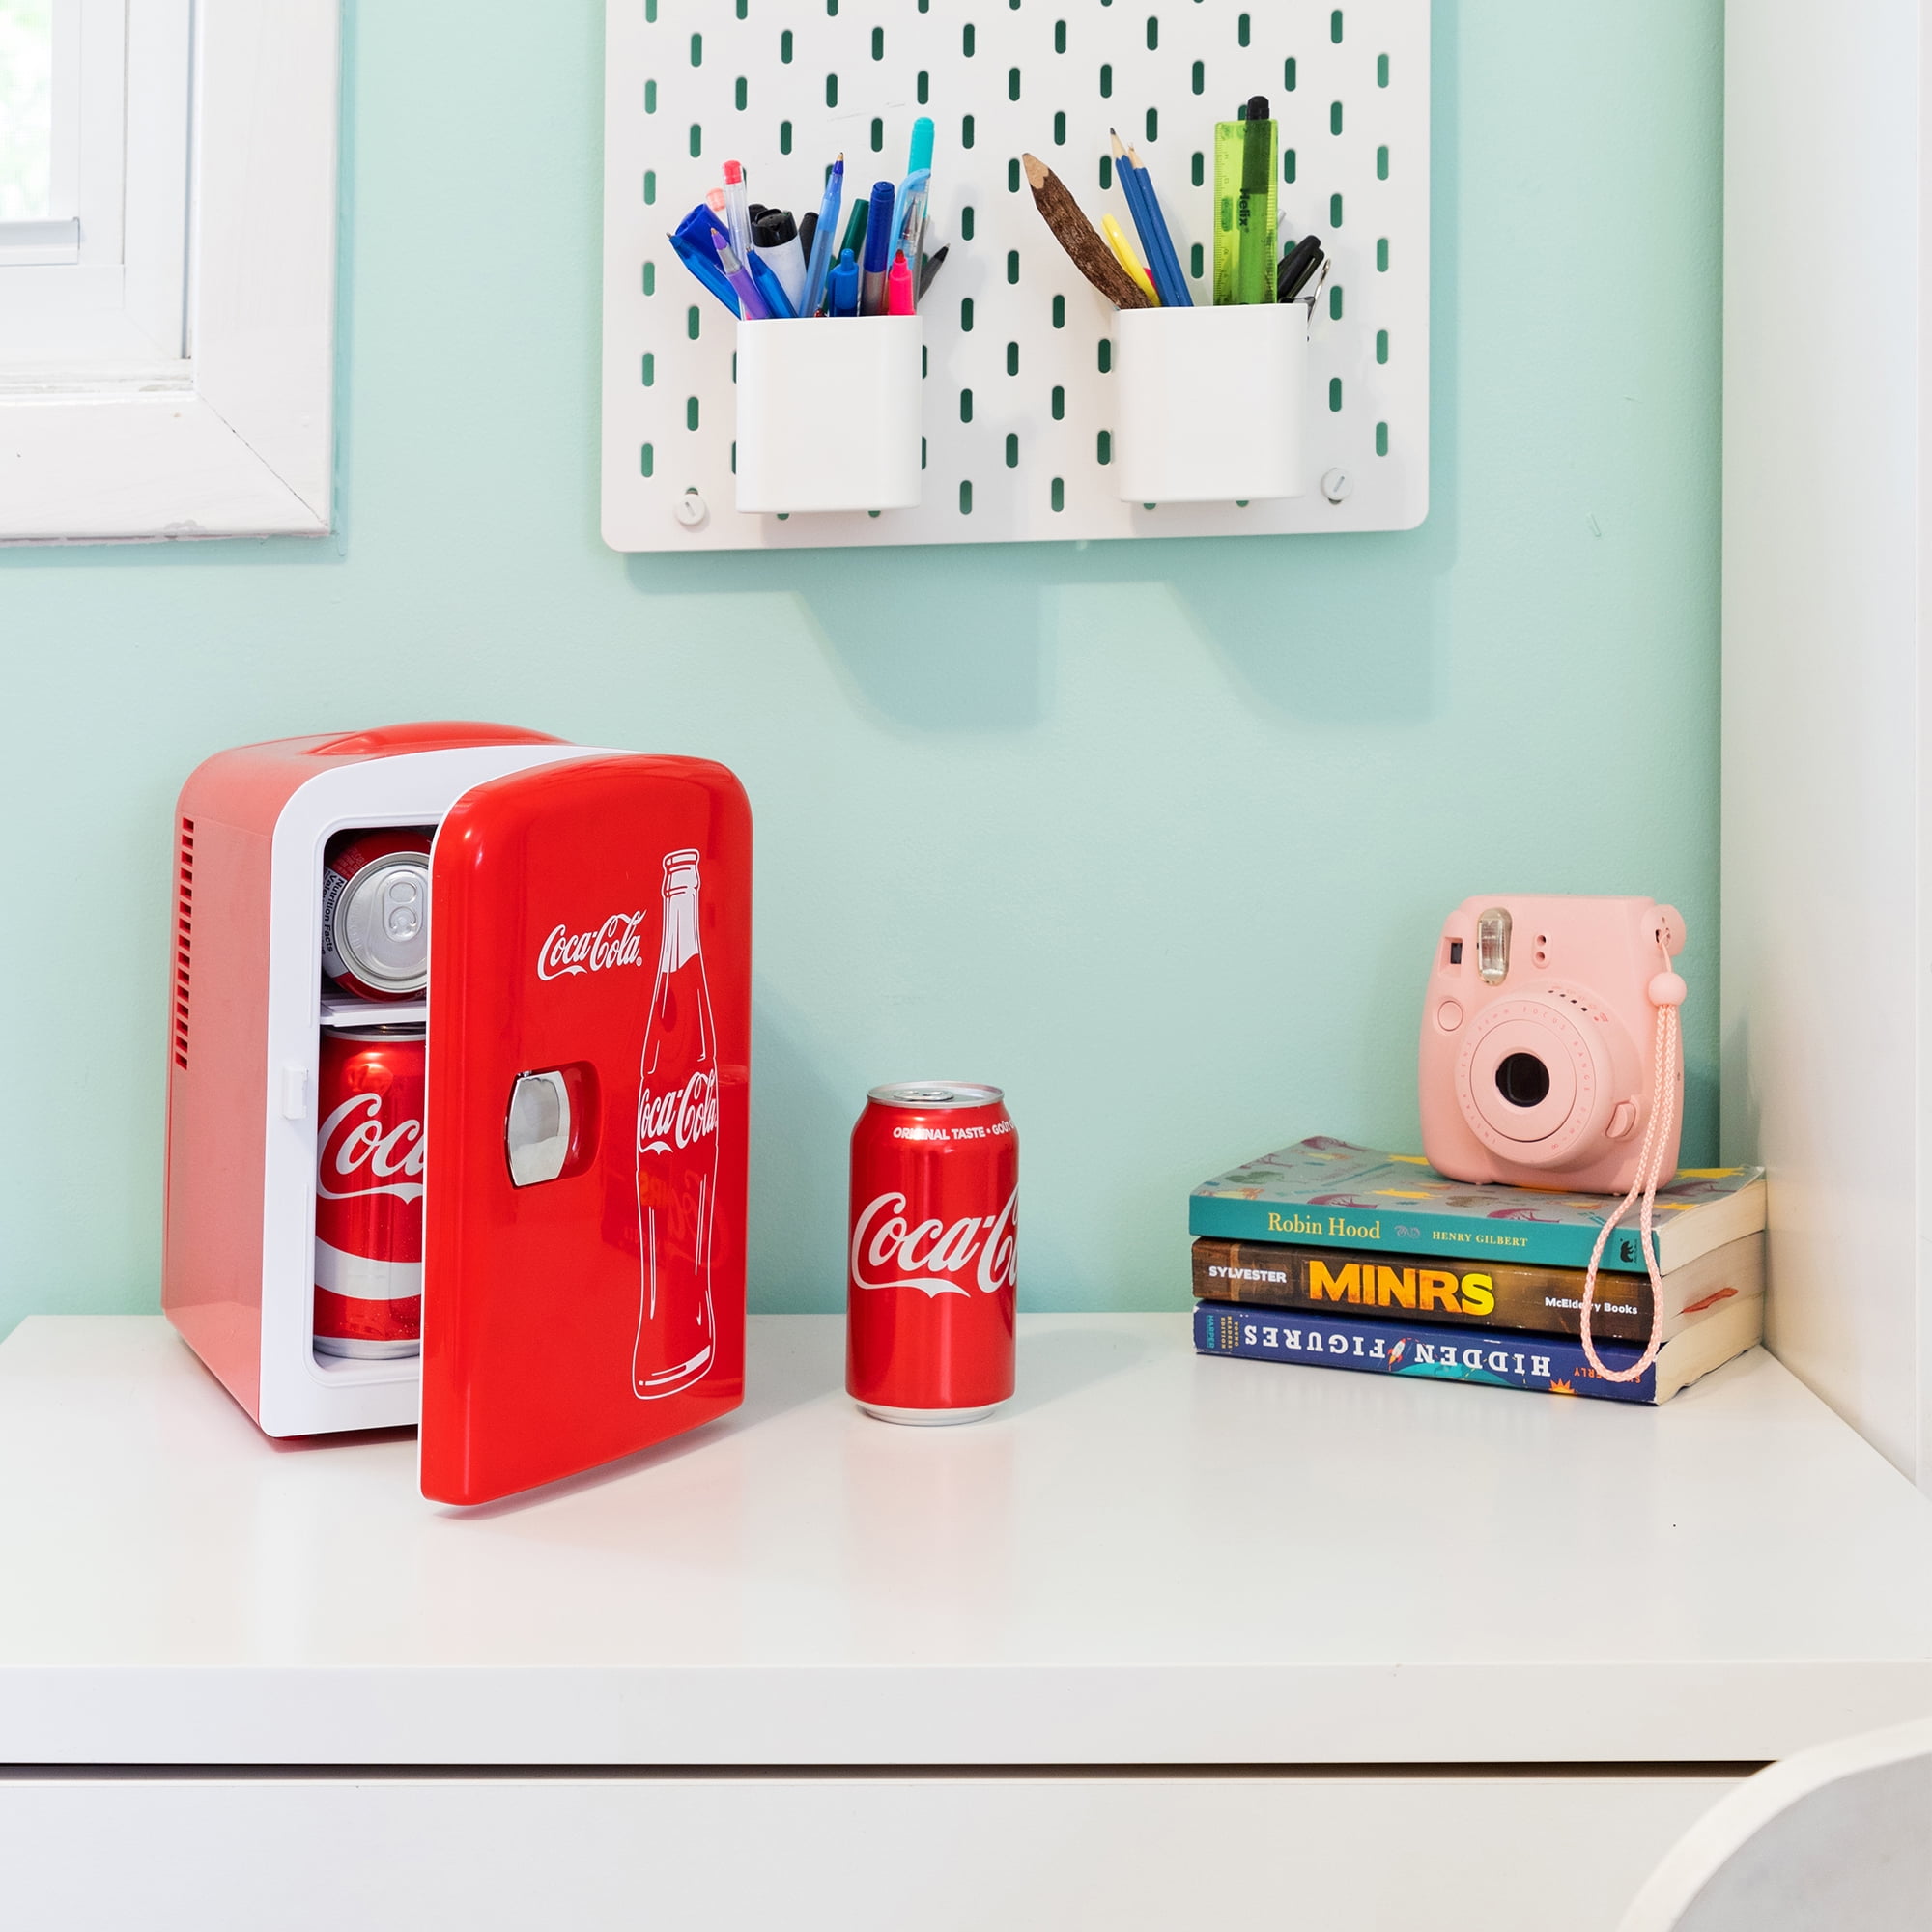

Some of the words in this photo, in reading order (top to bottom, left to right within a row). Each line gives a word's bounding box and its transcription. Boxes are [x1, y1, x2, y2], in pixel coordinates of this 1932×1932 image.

[1239, 187, 1251, 226] Helix
[322, 873, 337, 899] Vale
[325, 877, 345, 922] Nutrition
[324, 924, 334, 952] Facts
[537, 909, 647, 981] Coca-Cola
[639, 1068, 716, 1155] Coca-Cola
[952, 1126, 985, 1139] TASTE
[1268, 1212, 1322, 1235] Robin
[1328, 1217, 1380, 1239] Hood
[1432, 1231, 1471, 1242] HENRY
[1475, 1235, 1528, 1247] GILBERT
[1208, 1265, 1287, 1284] SYLVESTER
[1309, 1260, 1495, 1316] MINRS
[1604, 1302, 1638, 1315] Books
[1244, 1324, 1386, 1359] FIGURES
[1414, 1343, 1551, 1378] HIDDEN
